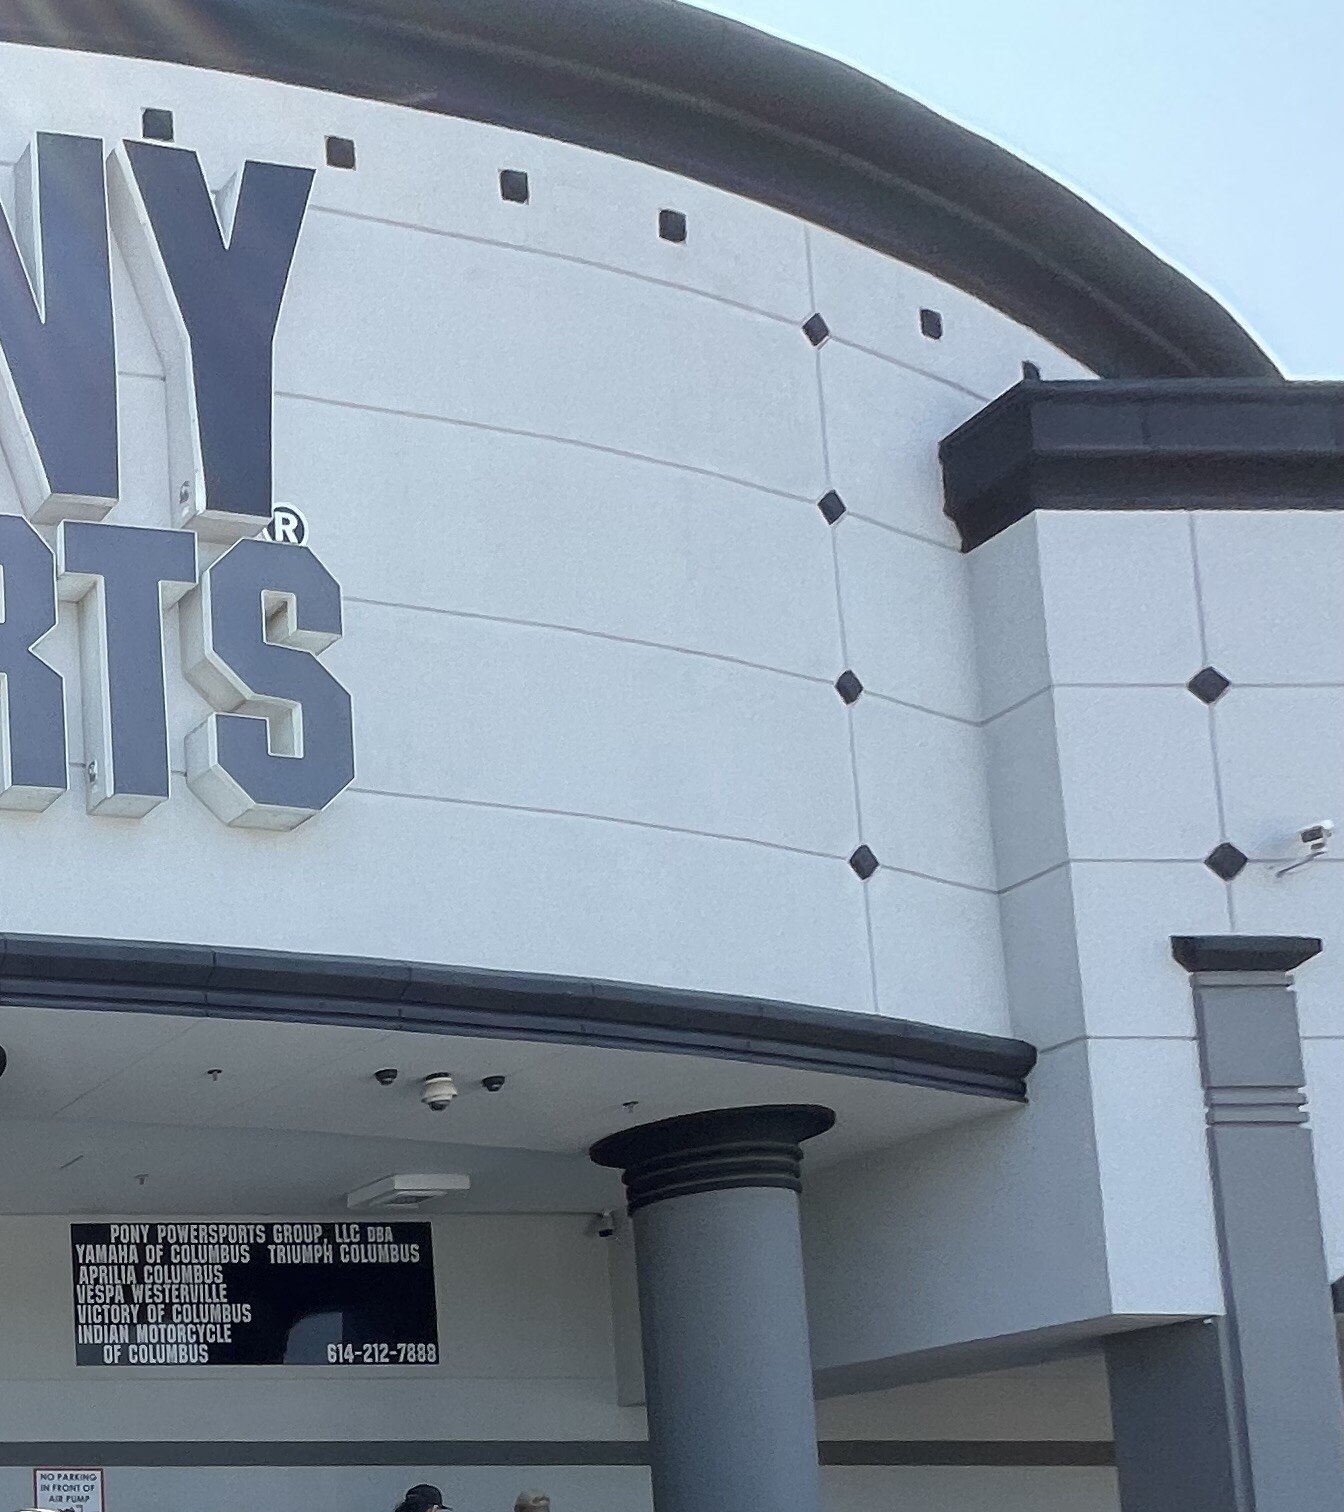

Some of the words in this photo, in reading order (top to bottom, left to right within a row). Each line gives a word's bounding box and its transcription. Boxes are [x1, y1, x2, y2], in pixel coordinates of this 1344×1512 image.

[110, 1224, 150, 1244] PONY
[157, 1224, 266, 1244] POWERSPORTS
[272, 1224, 328, 1245] GROUP,
[334, 1224, 360, 1243] LLC
[367, 1226, 393, 1242] DBA
[75, 1244, 139, 1264] YAMAHA
[145, 1244, 164, 1264] OF
[170, 1244, 251, 1264] COLUMBUS
[267, 1244, 334, 1264] TRIUMPH
[339, 1244, 420, 1263] COLUMBUS
[79, 1265, 137, 1284] APRILIA
[143, 1265, 224, 1284] COLUMBUS
[76, 1284, 125, 1303] VESPA
[131, 1284, 228, 1303] WESTERVILLE
[77, 1304, 140, 1323] VICTORY
[146, 1304, 165, 1323] OF
[172, 1303, 252, 1323] COLUMBUS
[78, 1324, 129, 1344] INDIAN
[136, 1324, 232, 1343] MOTORCYCLE
[103, 1344, 122, 1364] OF
[128, 1344, 209, 1364] COLUMBUS
[326, 1343, 437, 1363] 614-212-7888
[40, 1473, 55, 1481] NO
[57, 1473, 98, 1481] PARKING
[40, 1484, 50, 1492] IN
[82, 1484, 95, 1492] OF
